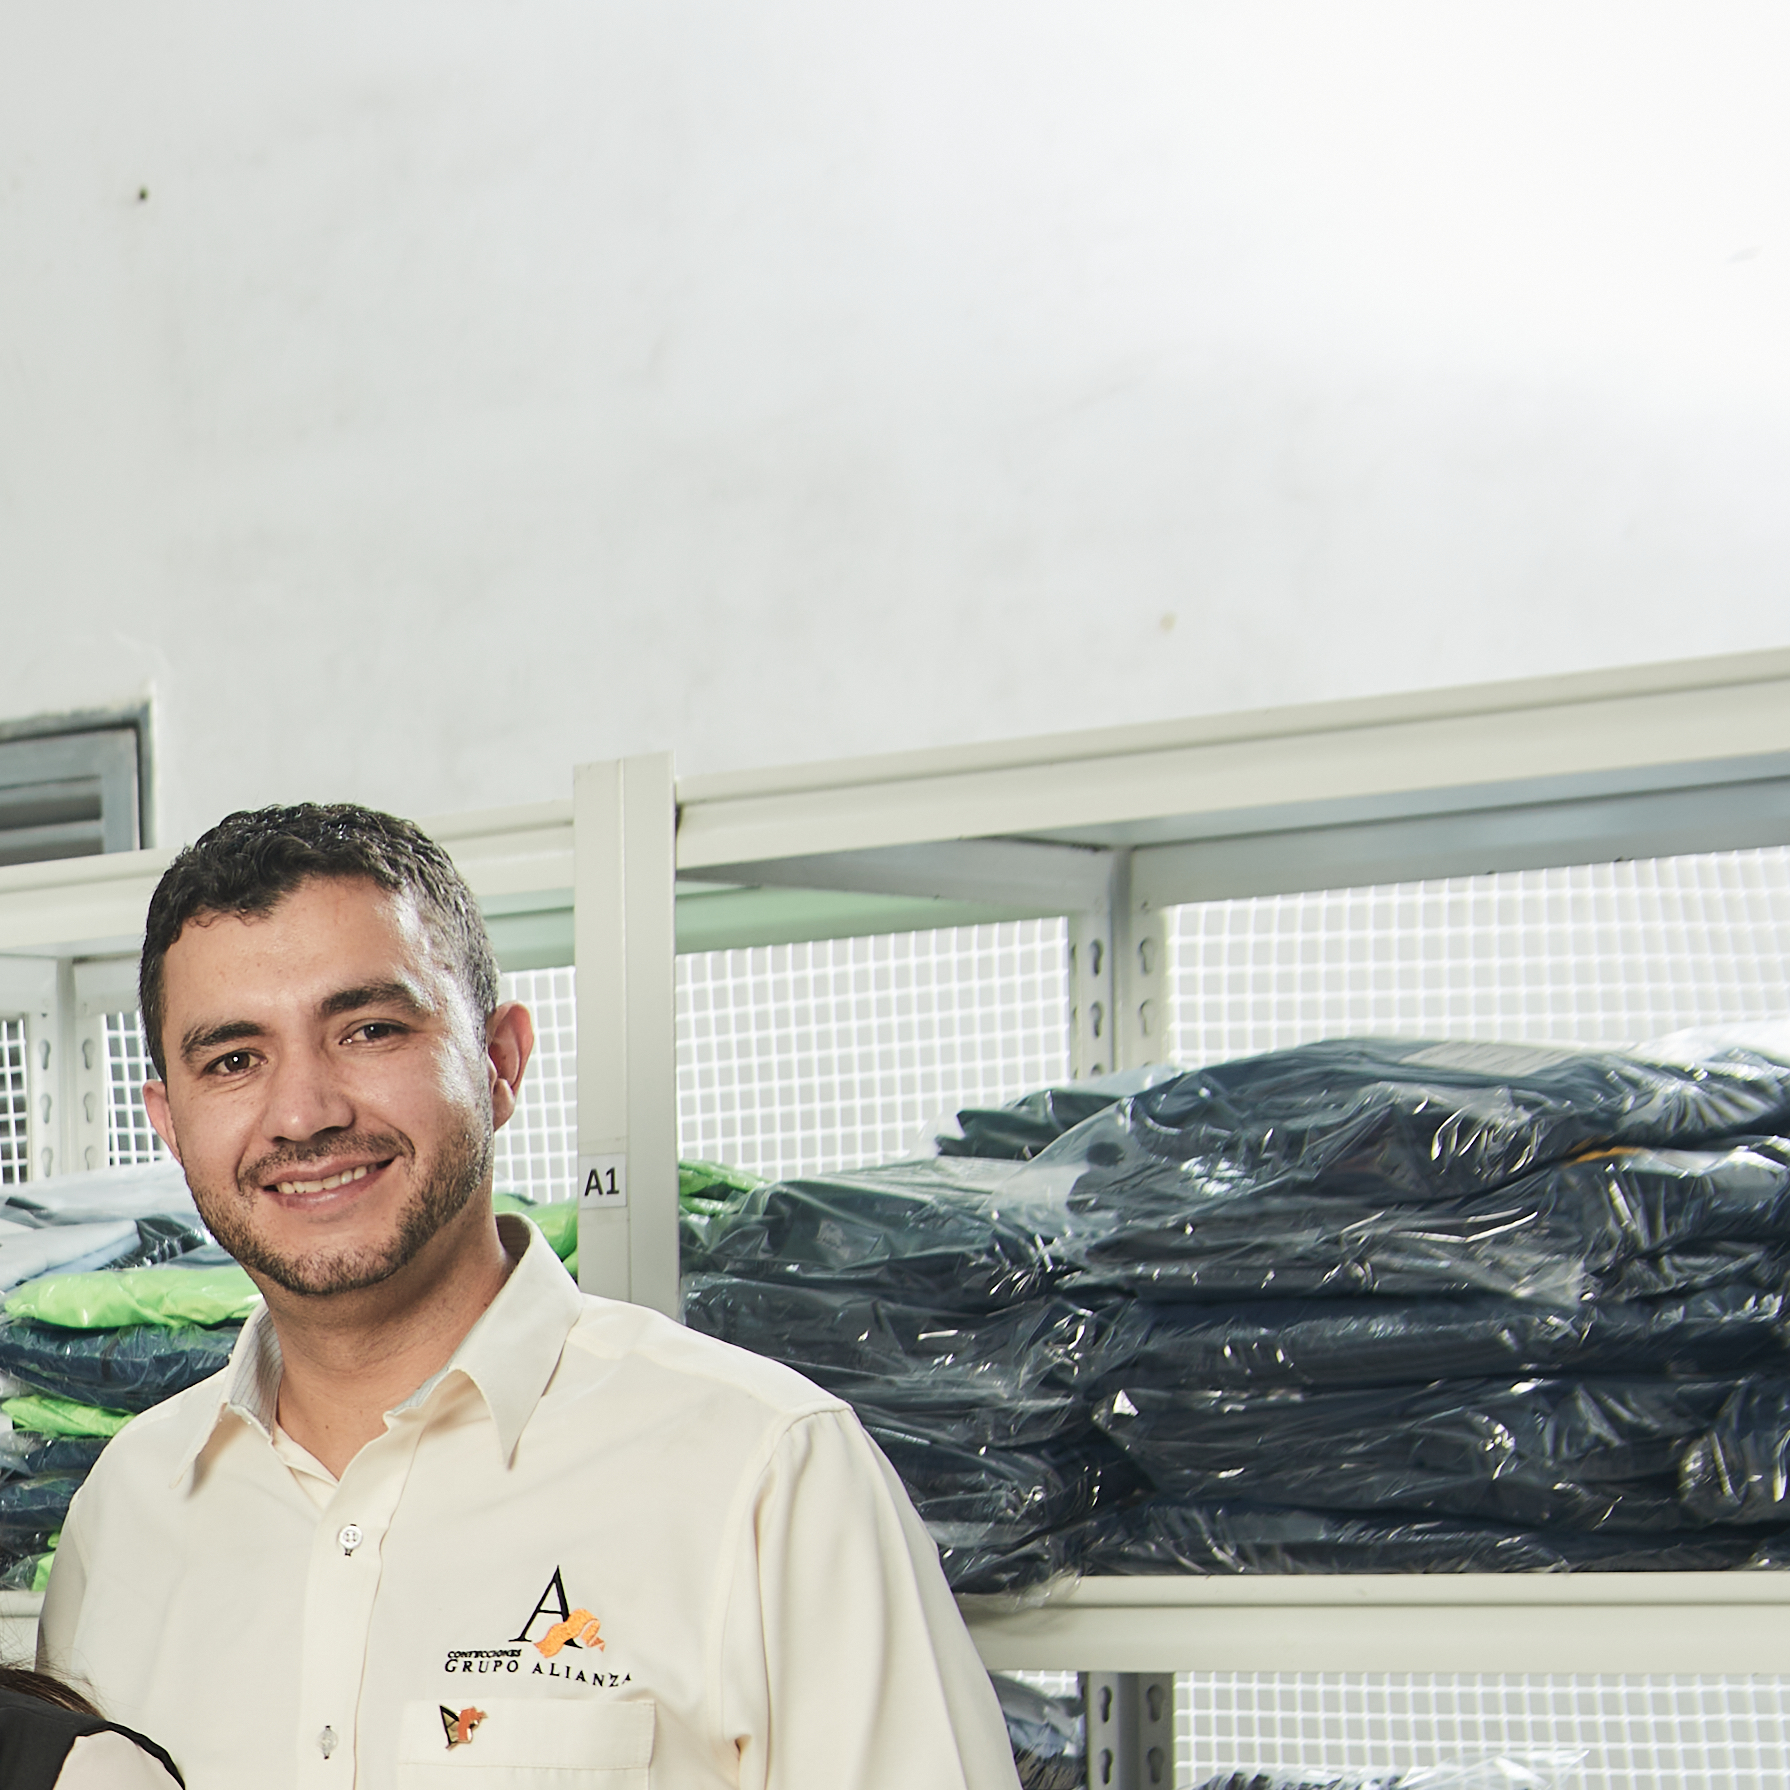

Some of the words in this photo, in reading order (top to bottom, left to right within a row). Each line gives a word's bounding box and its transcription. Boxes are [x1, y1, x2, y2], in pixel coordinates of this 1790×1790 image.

[584, 1166, 620, 1197] A1
[508, 1564, 583, 1650] A
[445, 1659, 519, 1674] GRUPO
[532, 1662, 632, 1688] ALIANZA
